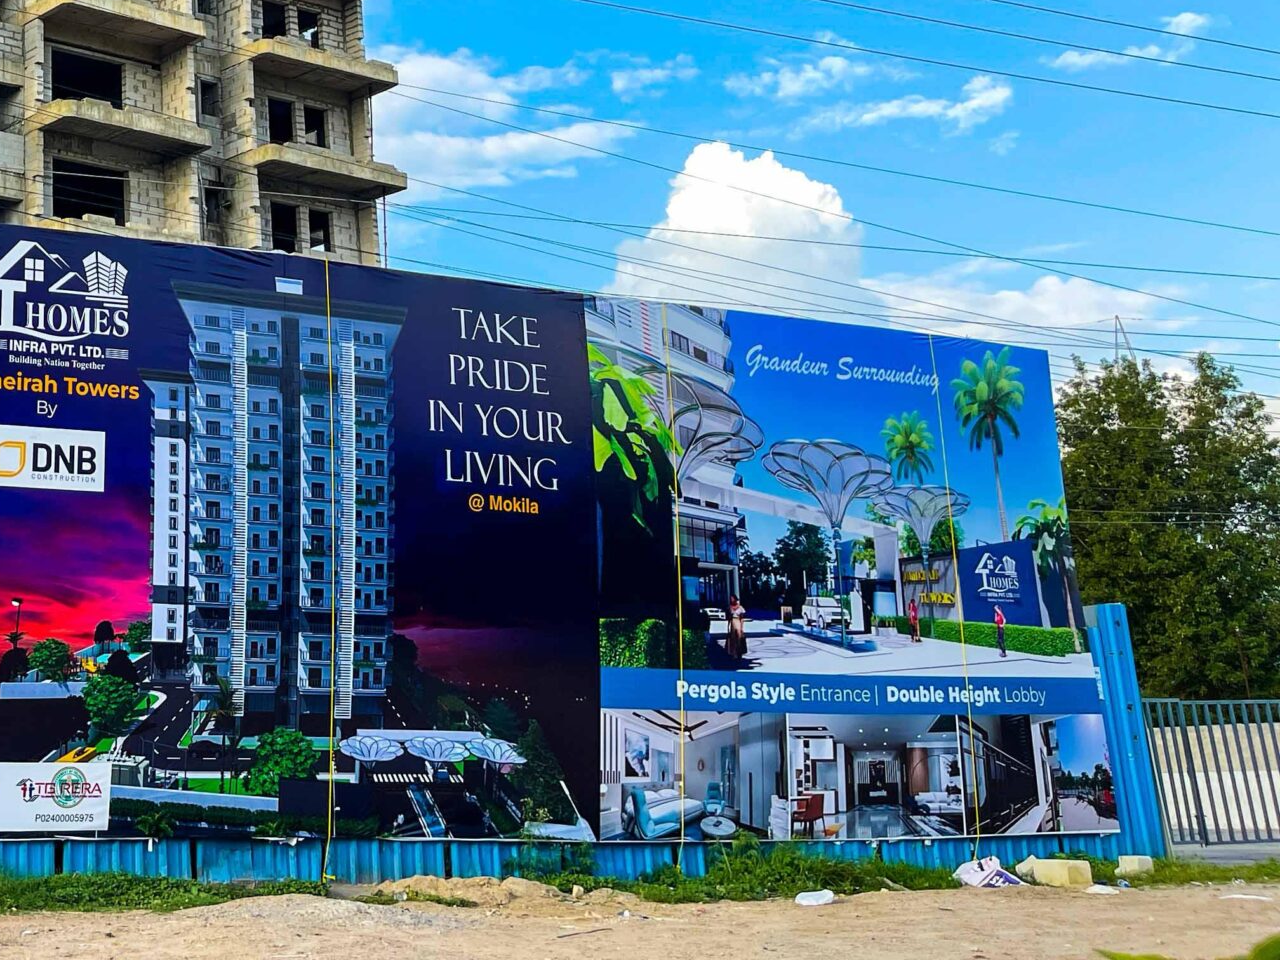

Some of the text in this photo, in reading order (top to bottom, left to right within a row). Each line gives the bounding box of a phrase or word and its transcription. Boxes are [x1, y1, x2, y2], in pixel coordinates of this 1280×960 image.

[25, 301, 130, 338] HOMES
[451, 307, 541, 348] TAKE
[9, 339, 105, 359] INFRA PVT. LTD.
[8, 354, 106, 371] Building Nation Together
[448, 353, 550, 396] PRIDE
[745, 344, 940, 395] Grandeur Surrounding
[63, 376, 140, 400] Towers
[36, 400, 58, 418] By
[428, 399, 573, 444] IN YOUR
[32, 442, 96, 474] DNB
[444, 449, 559, 491] LIVING
[31, 473, 96, 483] CONSTRUCTION
[468, 493, 539, 515] @ Mokila
[989, 577, 1019, 589] HOMES
[676, 679, 1047, 707] Pergola Style Entrance Double Height Lobby
[61, 783, 102, 794] RERA
[35, 813, 94, 822] P02400005975
